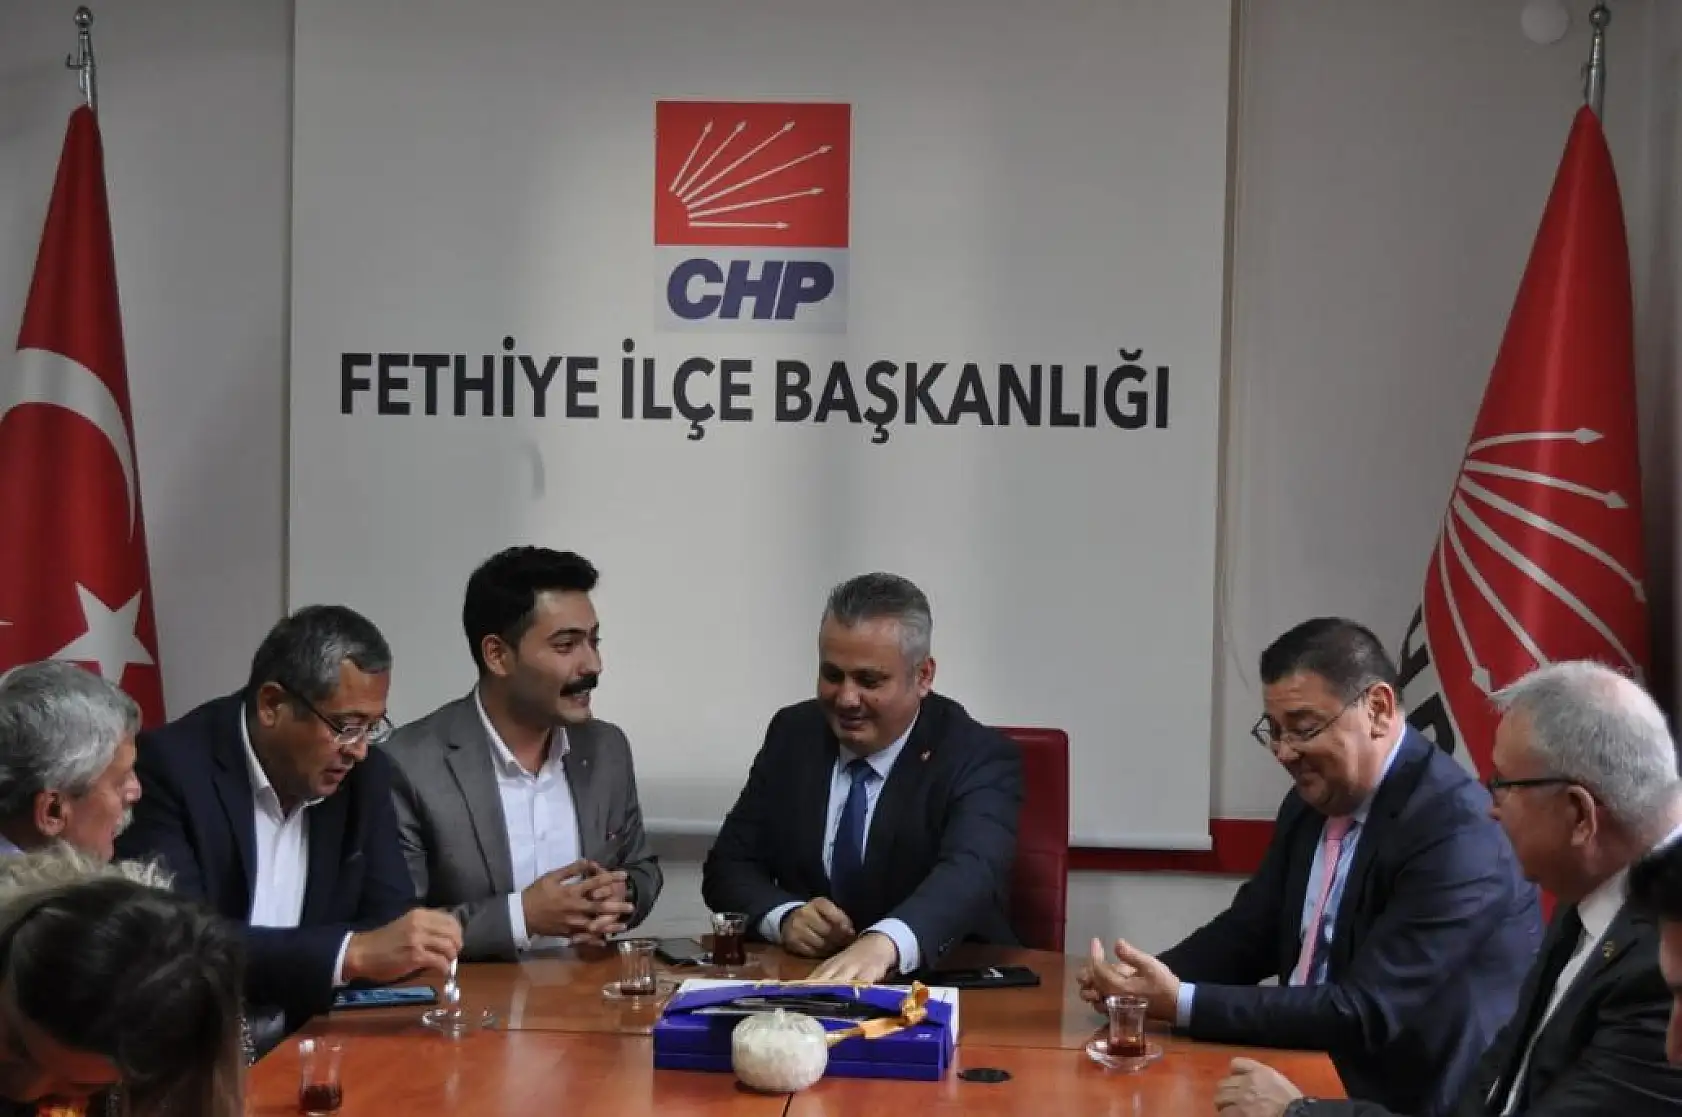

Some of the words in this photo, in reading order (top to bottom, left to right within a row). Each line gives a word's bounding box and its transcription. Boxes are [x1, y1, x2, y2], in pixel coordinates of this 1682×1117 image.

[667, 258, 834, 319] CHP
[340, 336, 599, 418] FETHİYE
[622, 339, 752, 440] İLÇE
[775, 348, 1169, 443] BAŞKANLIĞI
